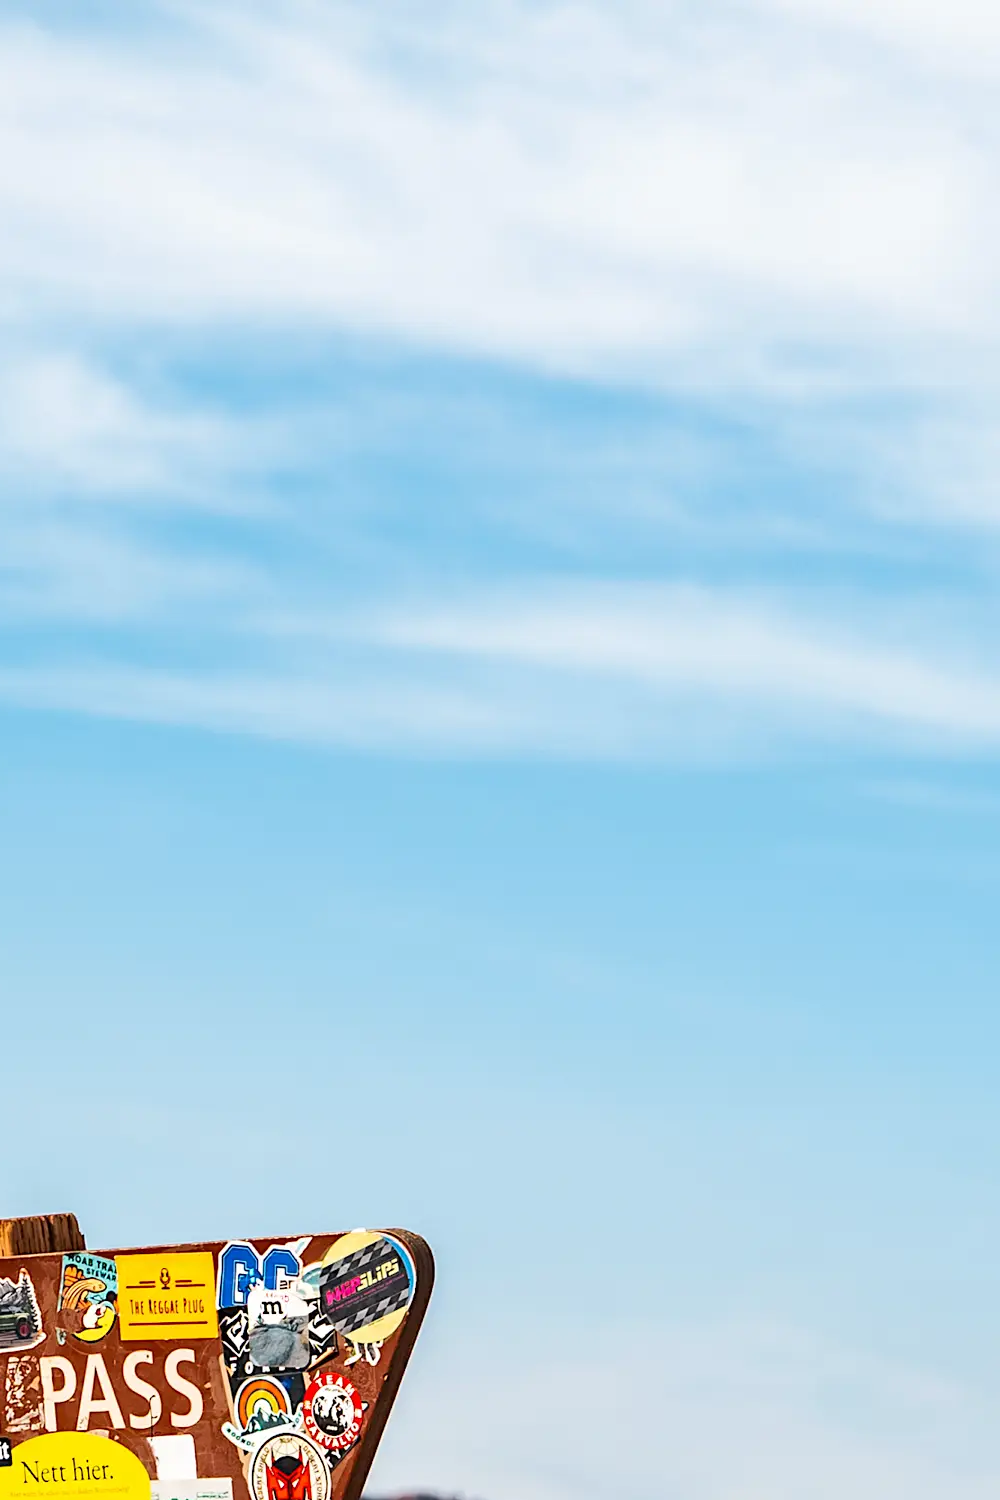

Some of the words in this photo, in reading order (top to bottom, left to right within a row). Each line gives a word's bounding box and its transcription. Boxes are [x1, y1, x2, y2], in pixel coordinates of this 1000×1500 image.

[40, 1348, 203, 1431] PASS
[316, 1375, 355, 1396] TEAM
[305, 1416, 359, 1448] CARVALHO
[21, 1461, 66, 1483] Nett
[72, 1458, 113, 1481] hier.
